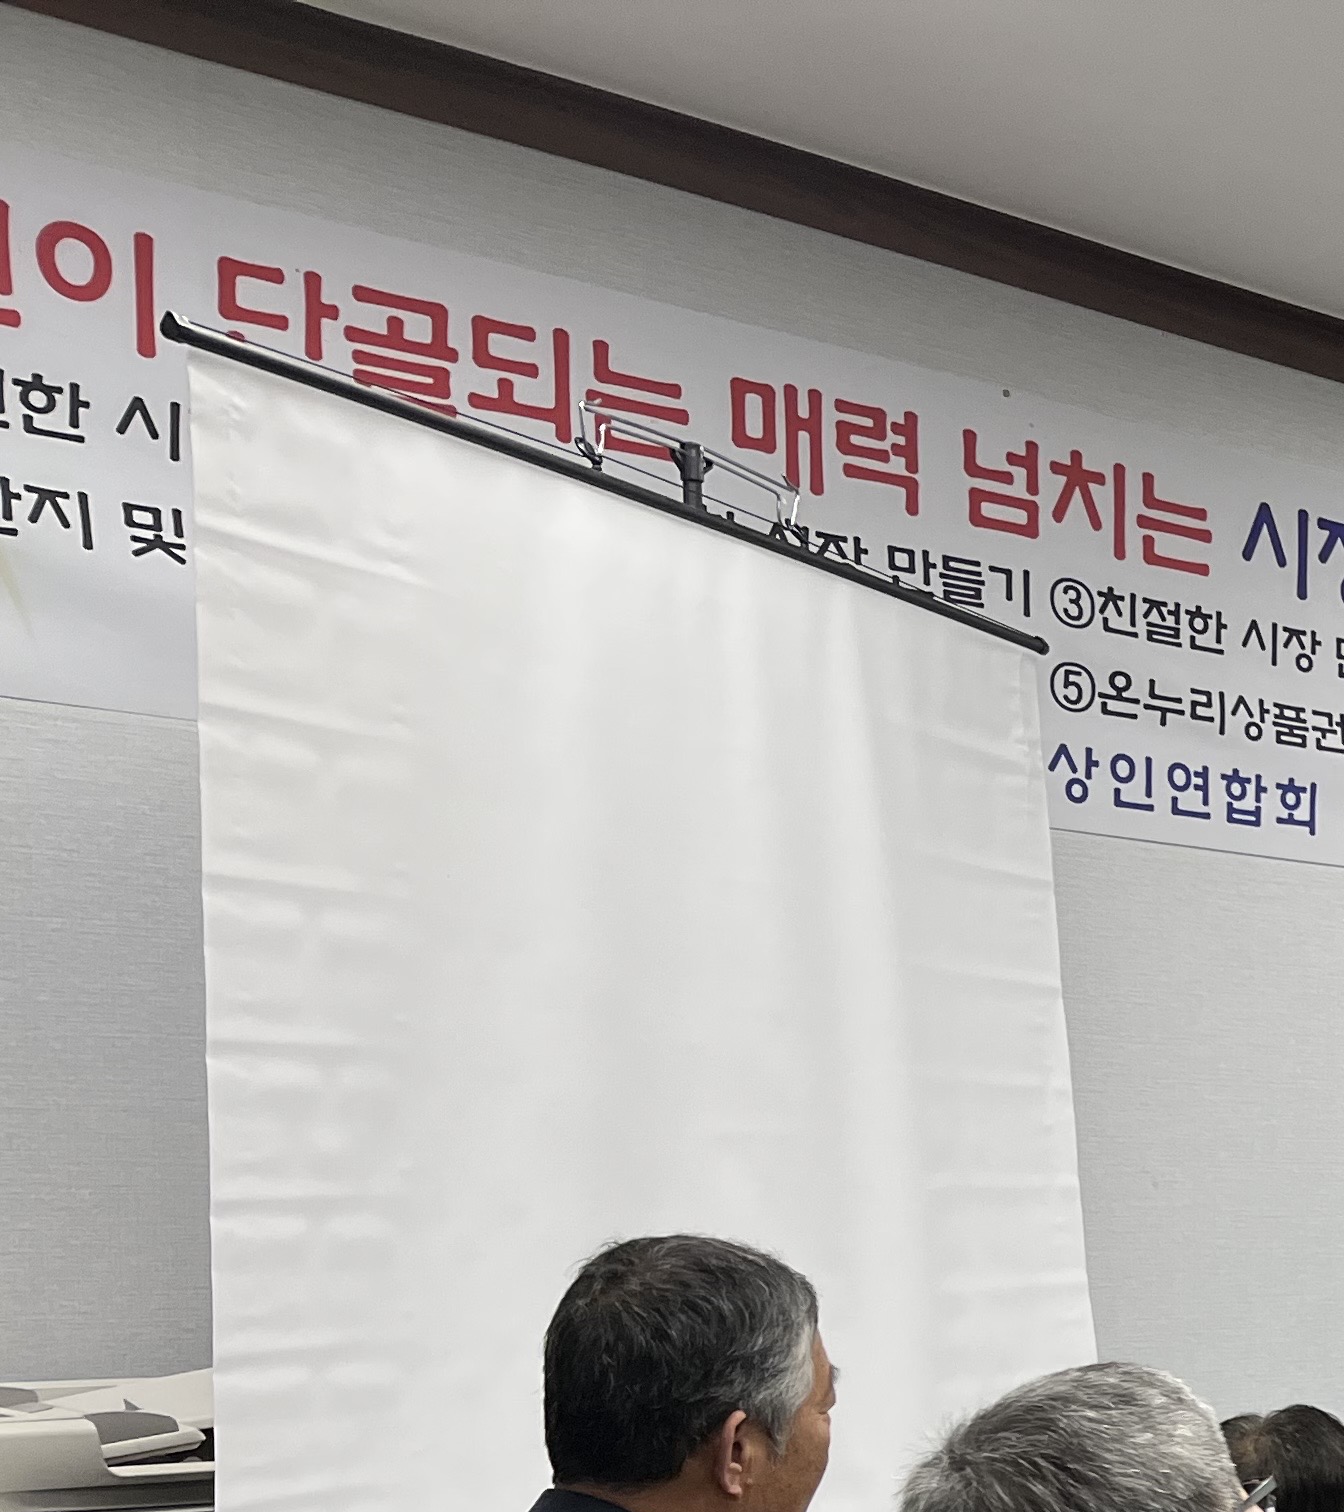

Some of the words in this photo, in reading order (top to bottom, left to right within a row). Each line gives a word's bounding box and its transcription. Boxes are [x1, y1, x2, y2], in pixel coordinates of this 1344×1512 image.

[730, 377, 919, 516] 매력
[963, 429, 1212, 577] 넘치는
[122, 501, 187, 565] 및
[887, 545, 1030, 617] 만들기
[1241, 618, 1321, 673] 시장
[1048, 742, 1317, 836] 상인연합회
